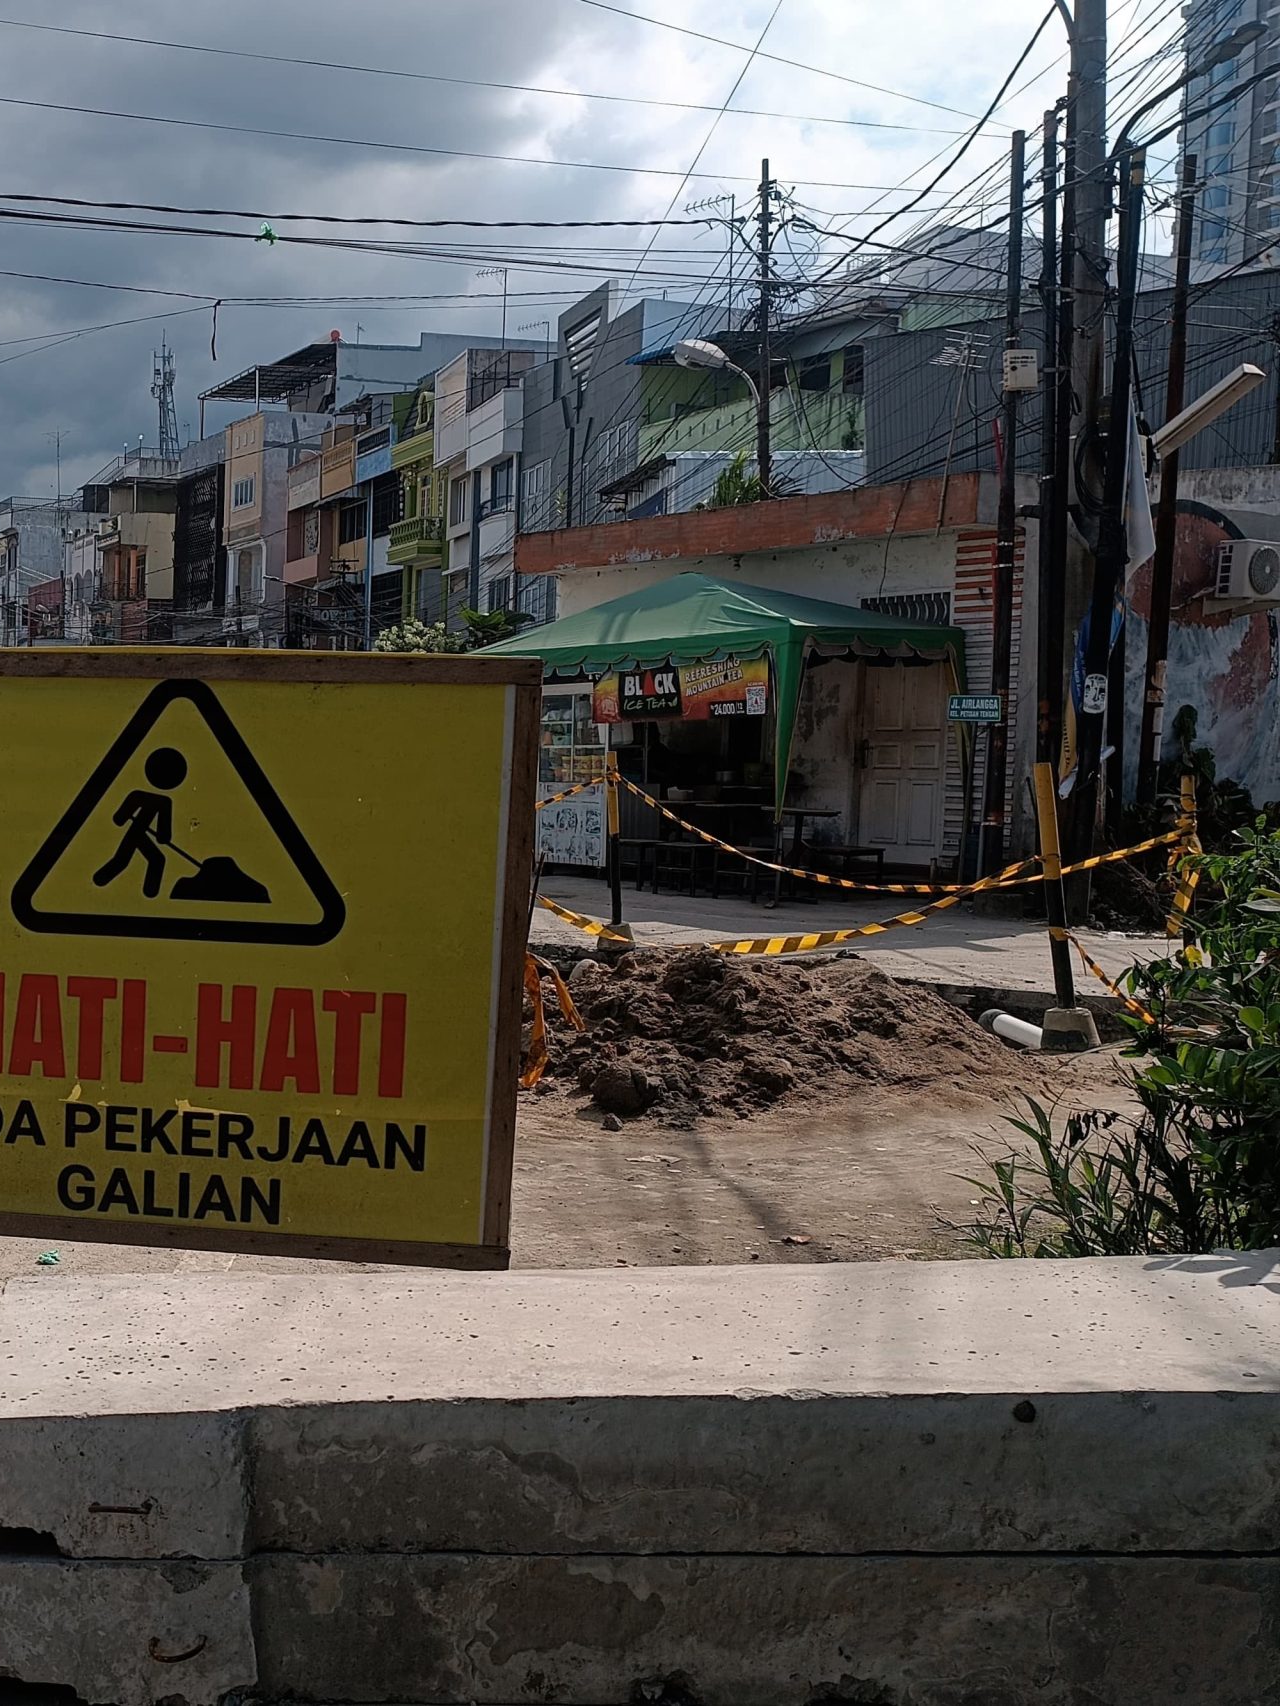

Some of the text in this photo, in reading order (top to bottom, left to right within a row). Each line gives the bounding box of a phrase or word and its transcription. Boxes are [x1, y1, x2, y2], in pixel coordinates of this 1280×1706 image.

[685, 658, 741, 683] REFRESHING
[686, 669, 743, 697] MOUNTAIN TEA
[624, 671, 676, 696] BLACK
[623, 697, 666, 711] ICE TEA
[961, 698, 998, 709] AIRLANGGA
[64, 1102, 426, 1172] PEKERJAAN
[56, 1164, 281, 1226] GALIAN
